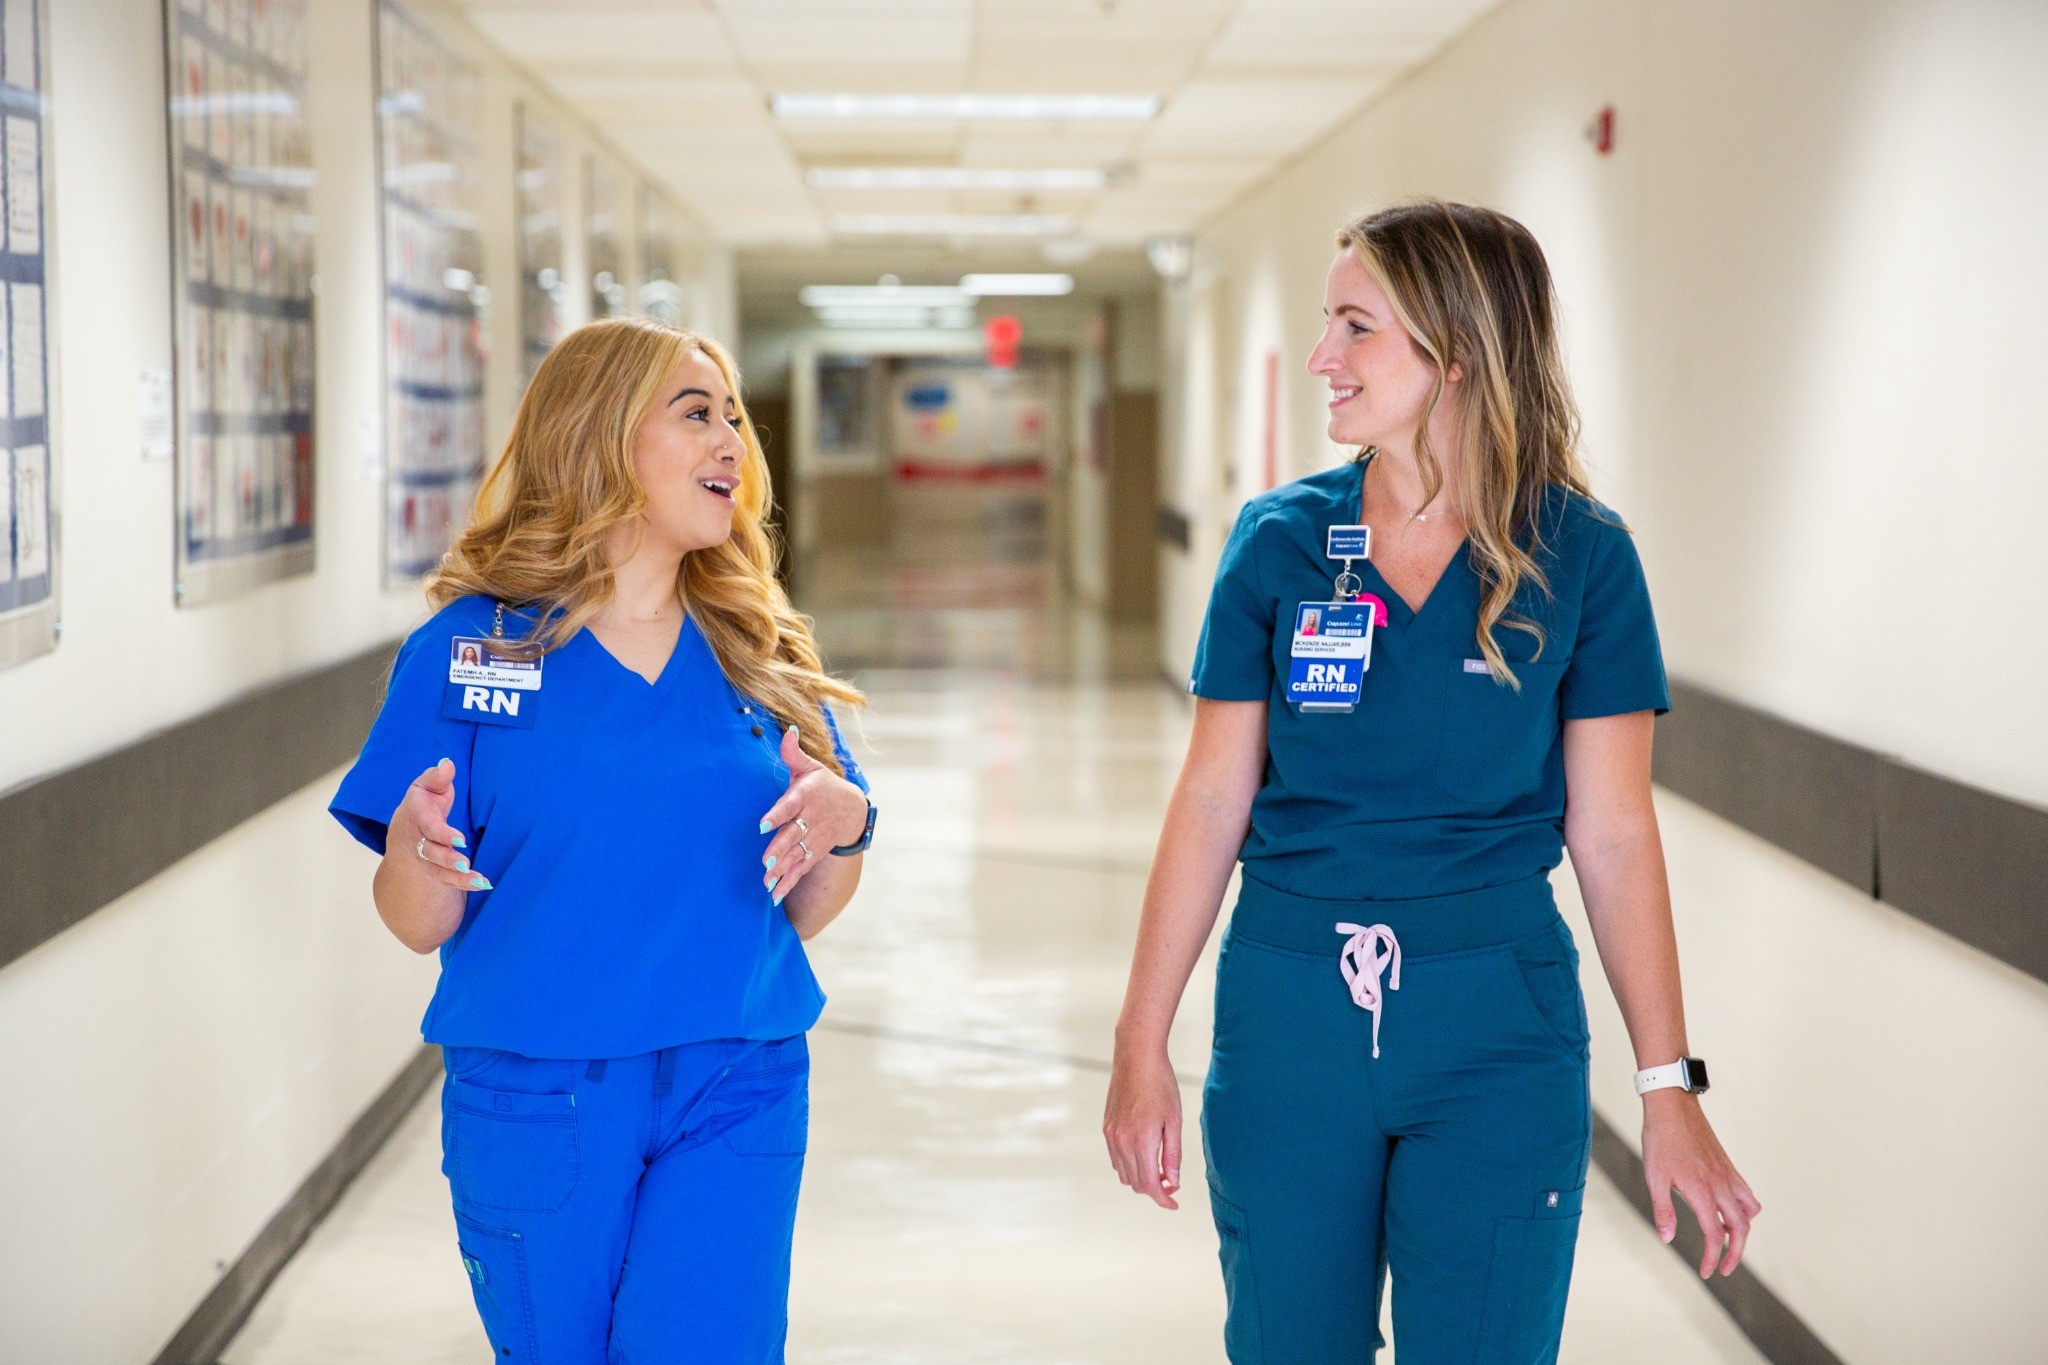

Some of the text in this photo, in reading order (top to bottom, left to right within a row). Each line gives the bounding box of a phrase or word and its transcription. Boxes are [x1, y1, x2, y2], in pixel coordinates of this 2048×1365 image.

[1306, 664, 1346, 683] RN
[1291, 682, 1357, 692] CERTIFIED
[463, 686, 520, 716] RN
